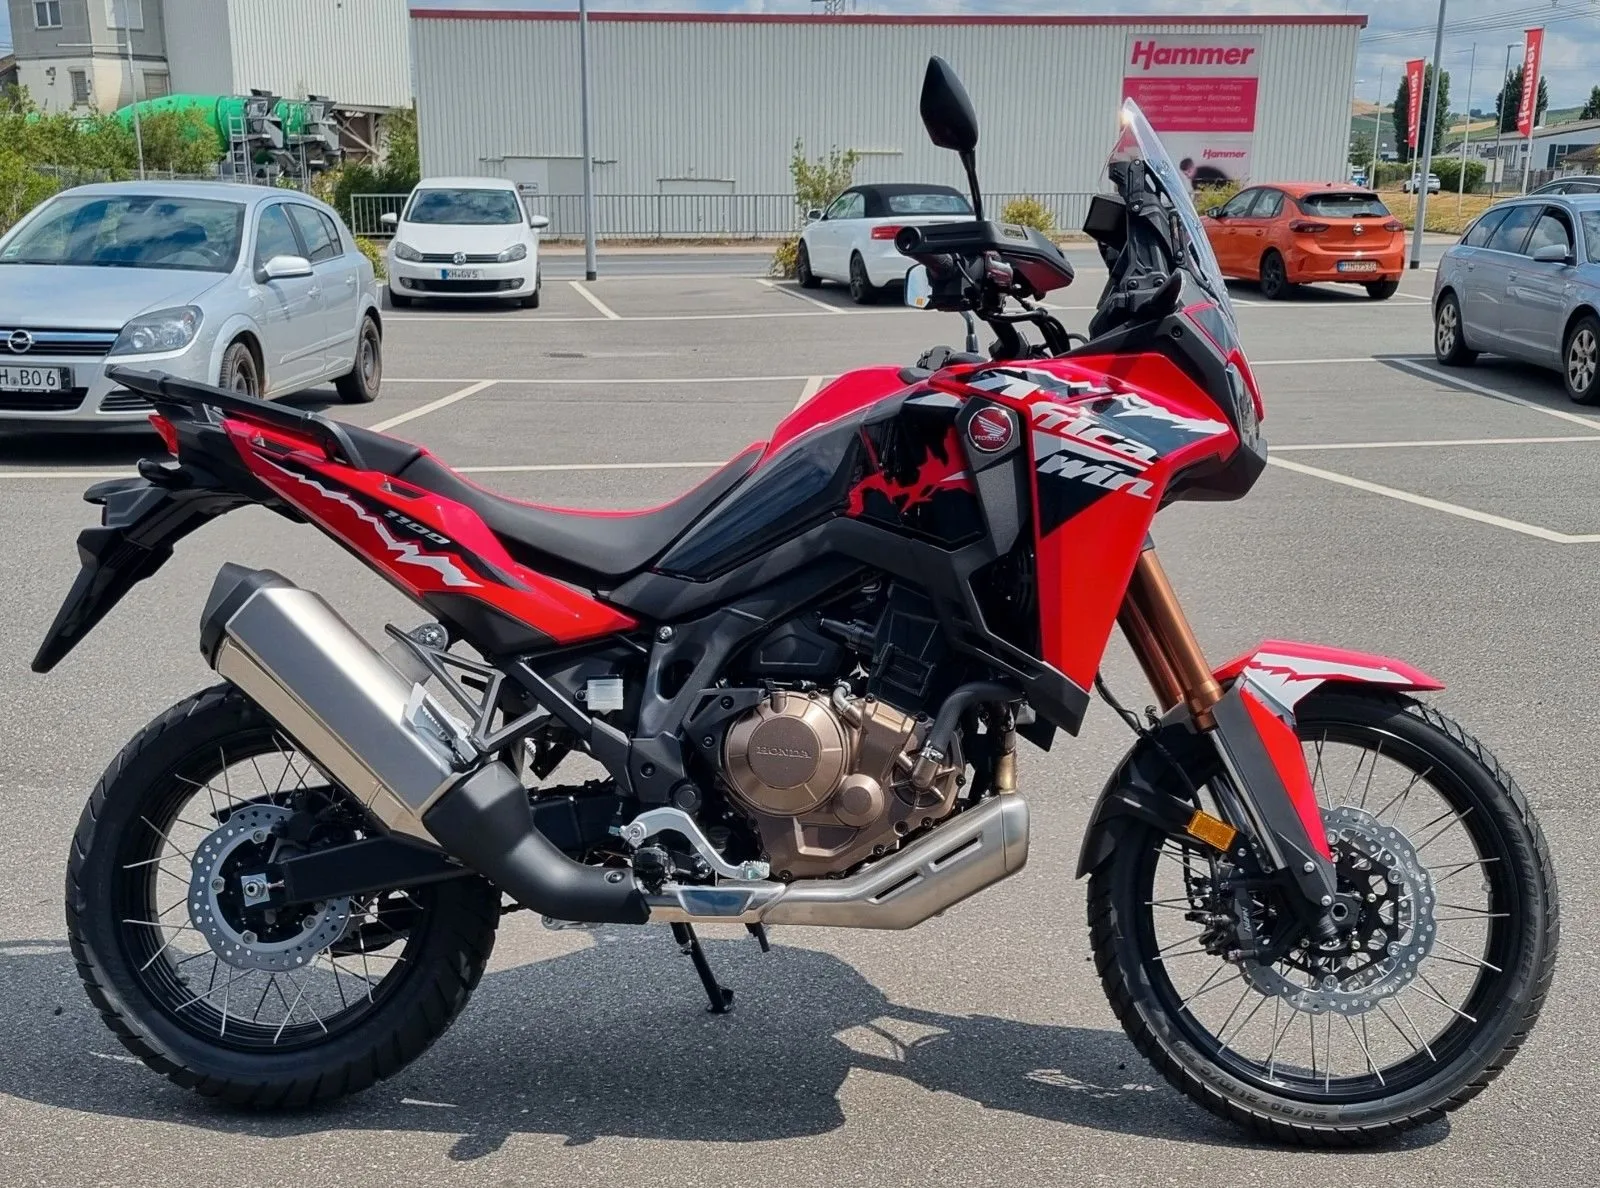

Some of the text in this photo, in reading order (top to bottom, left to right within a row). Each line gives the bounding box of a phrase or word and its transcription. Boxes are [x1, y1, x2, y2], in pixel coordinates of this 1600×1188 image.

[1131, 41, 1255, 70] Hammer
[1203, 149, 1246, 159] Hammer
[974, 435, 1005, 443] HONDA
[384, 509, 451, 545] 1100
[756, 746, 812, 759] HONDA
